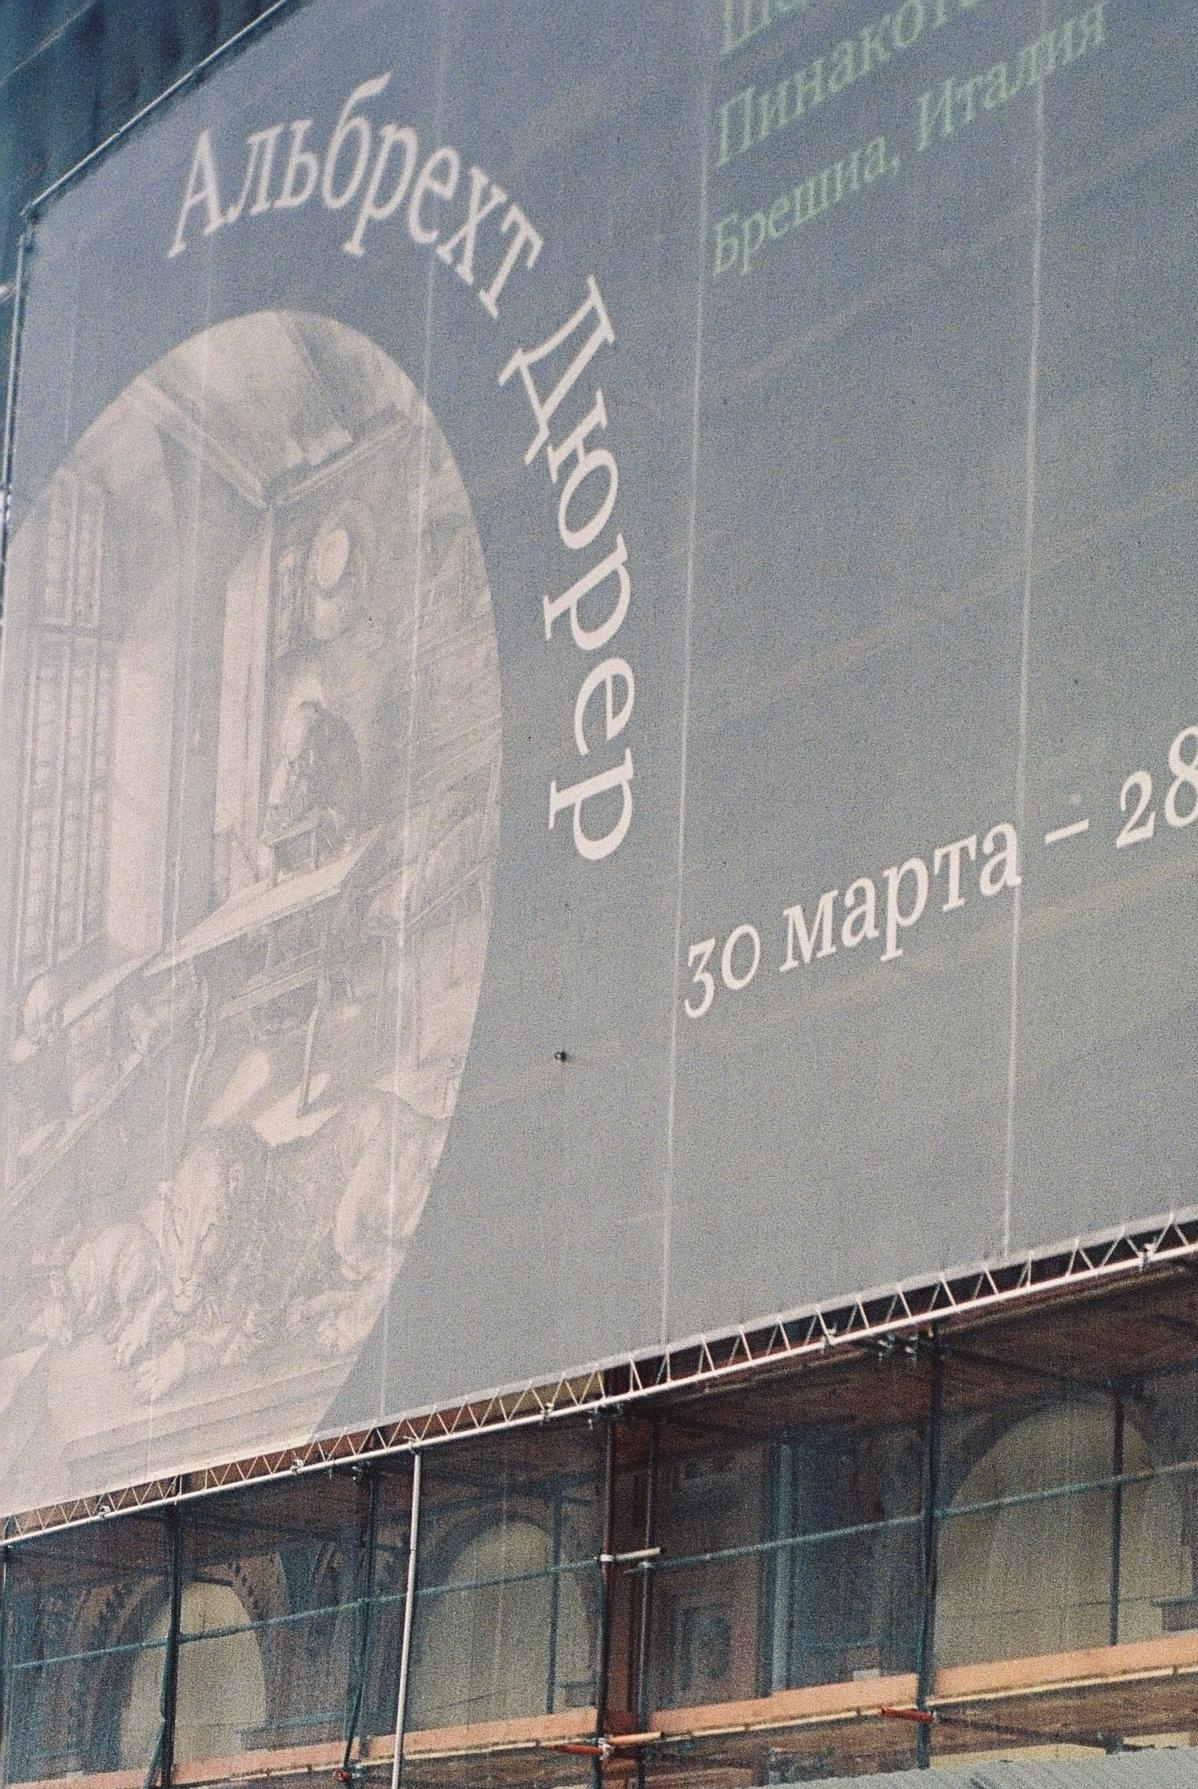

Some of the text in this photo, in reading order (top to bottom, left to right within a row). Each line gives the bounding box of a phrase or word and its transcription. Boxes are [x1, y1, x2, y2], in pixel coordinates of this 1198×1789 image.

[914, 2, 1108, 152] Италия
[168, 70, 636, 860] Альбрехт Дюрер
[684, 925, 760, 1018] 30
[777, 822, 1023, 970] марта
